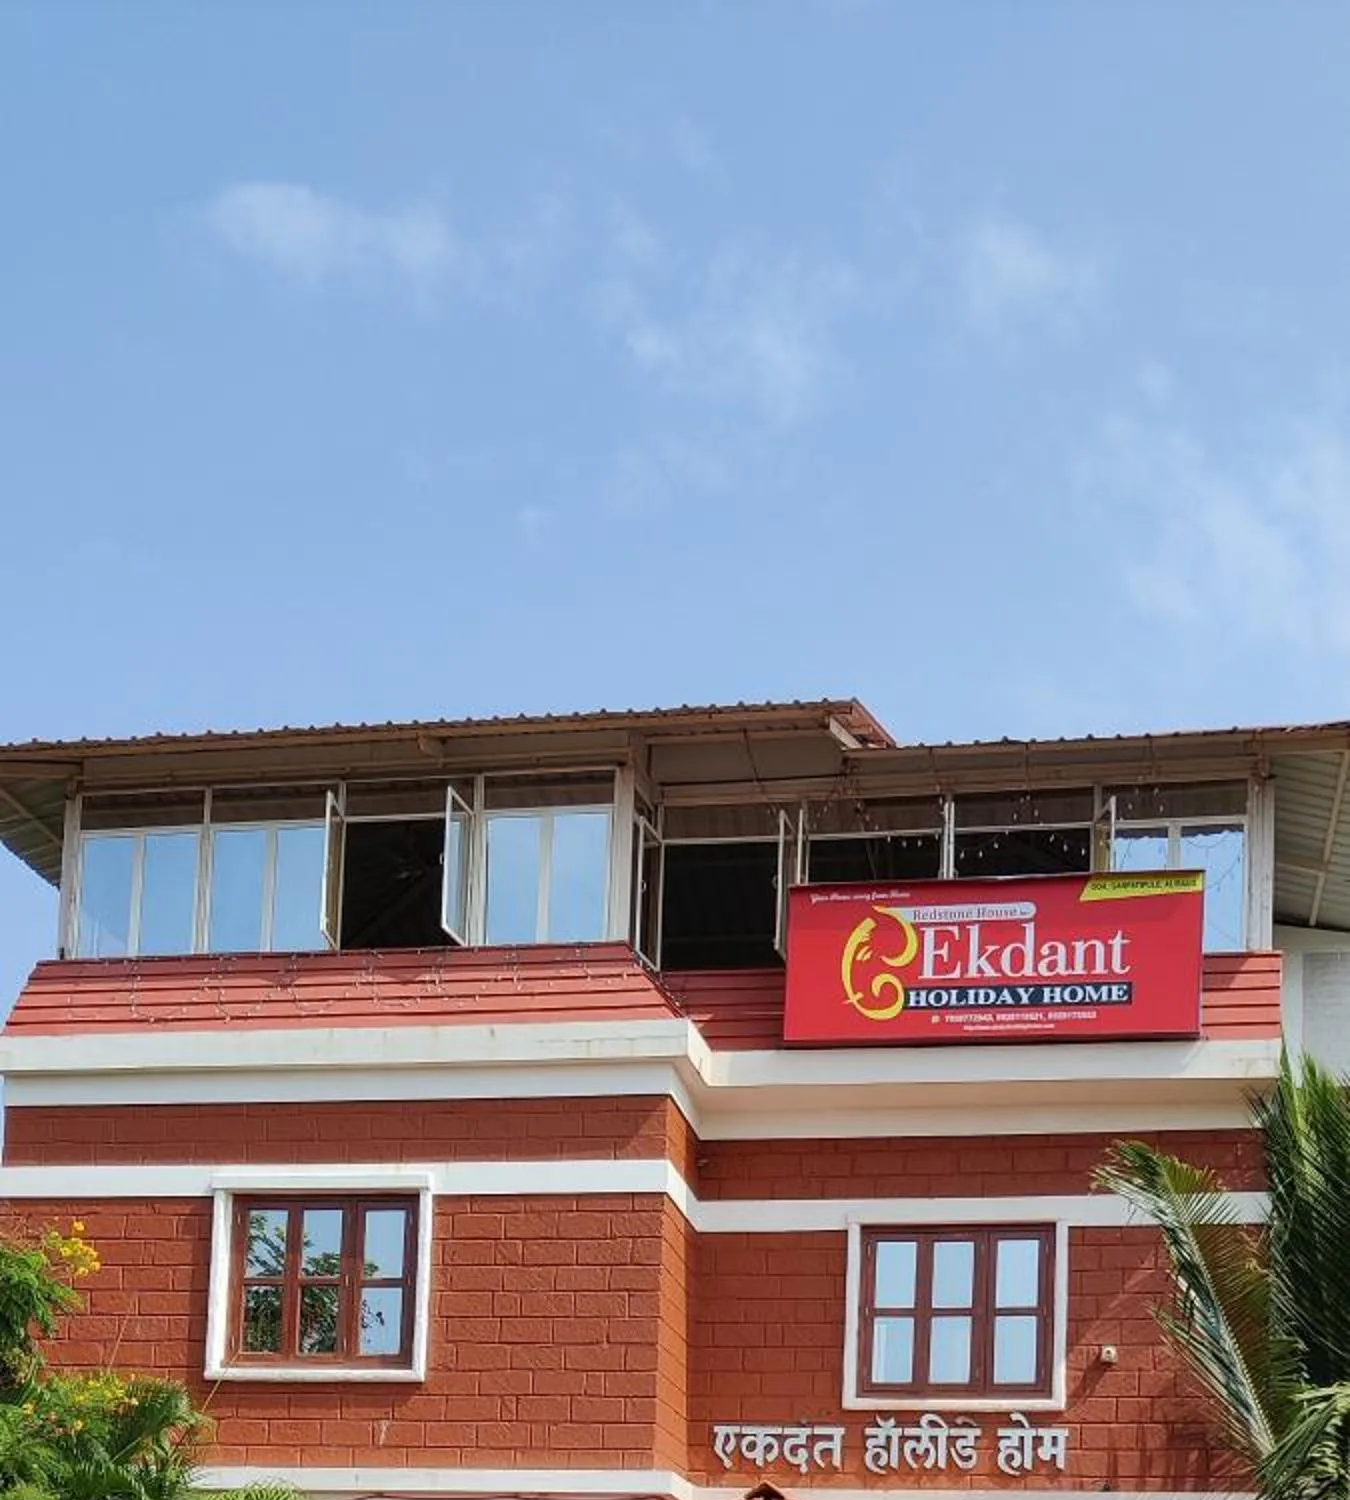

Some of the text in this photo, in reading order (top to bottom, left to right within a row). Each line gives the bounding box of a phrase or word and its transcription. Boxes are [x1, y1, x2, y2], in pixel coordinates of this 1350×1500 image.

[914, 903, 1018, 921] Redstone House
[918, 922, 1132, 980] Ekdant
[908, 984, 1129, 1007] HOLIDAY HOME
[712, 1411, 1070, 1476] एकदंत हॉलीडे होम
